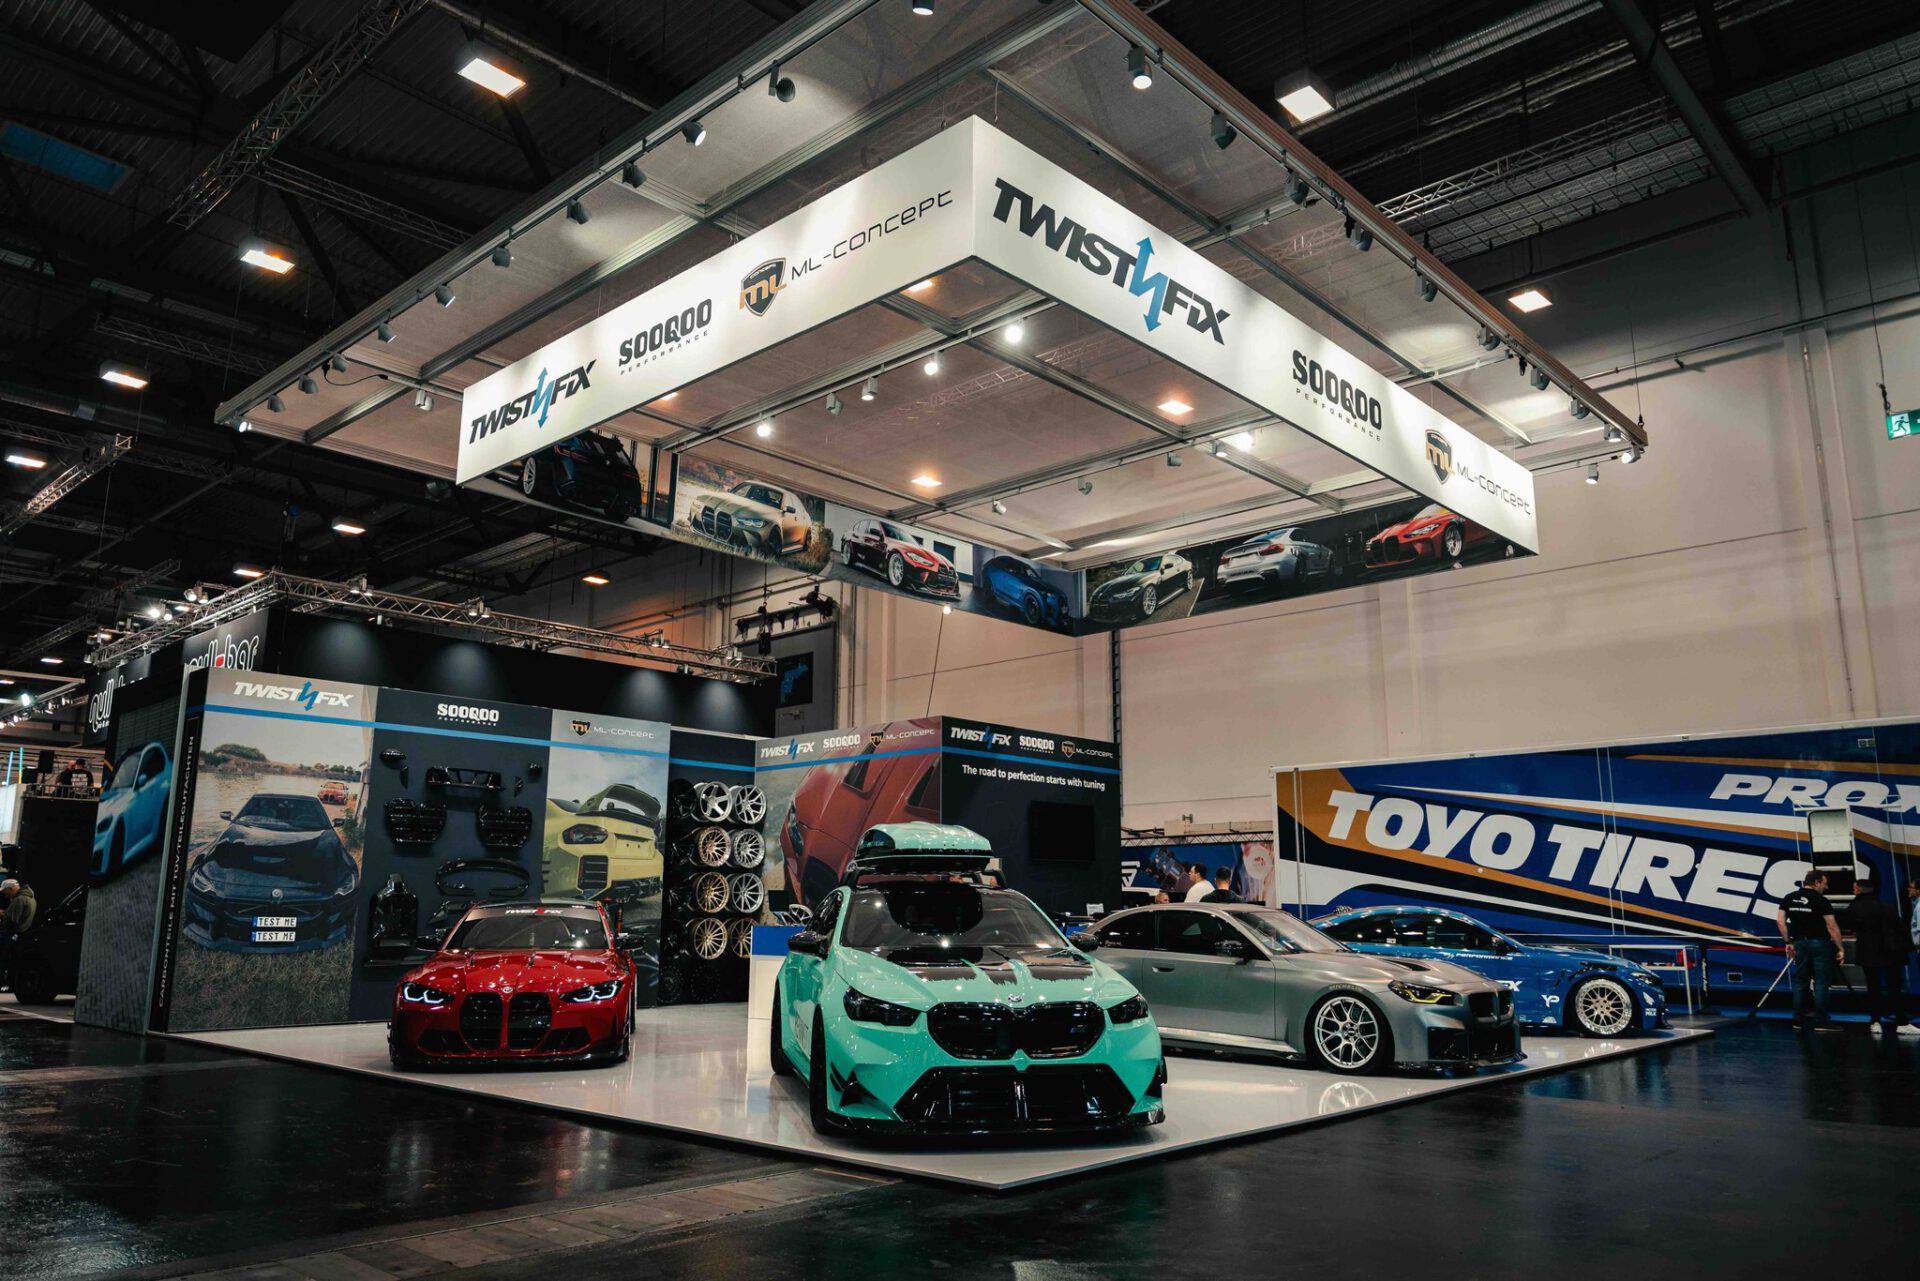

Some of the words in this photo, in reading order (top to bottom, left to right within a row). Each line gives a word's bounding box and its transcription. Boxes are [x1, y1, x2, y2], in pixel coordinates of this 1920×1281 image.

[618, 298, 712, 368] SOOQOO
[620, 330, 708, 375] PERFORMANCE
[1292, 350, 1382, 430] SOOQOO
[1296, 388, 1382, 442] PERFORMANCE
[437, 703, 500, 722] SOOQOO
[823, 734, 861, 749] SOOQOO
[1019, 735, 1054, 751] SOOQOO
[962, 764, 977, 775] The
[979, 767, 997, 778] road
[998, 769, 1006, 778] to
[1008, 769, 1045, 783] perfection
[1046, 775, 1066, 786] starts
[1067, 776, 1083, 787] with
[1083, 778, 1106, 792] tuning
[1327, 789, 1536, 872] TOYO
[258, 917, 280, 926] TEST
[284, 918, 296, 926] ME
[257, 932, 279, 941] TEST
[283, 933, 294, 941] ME
